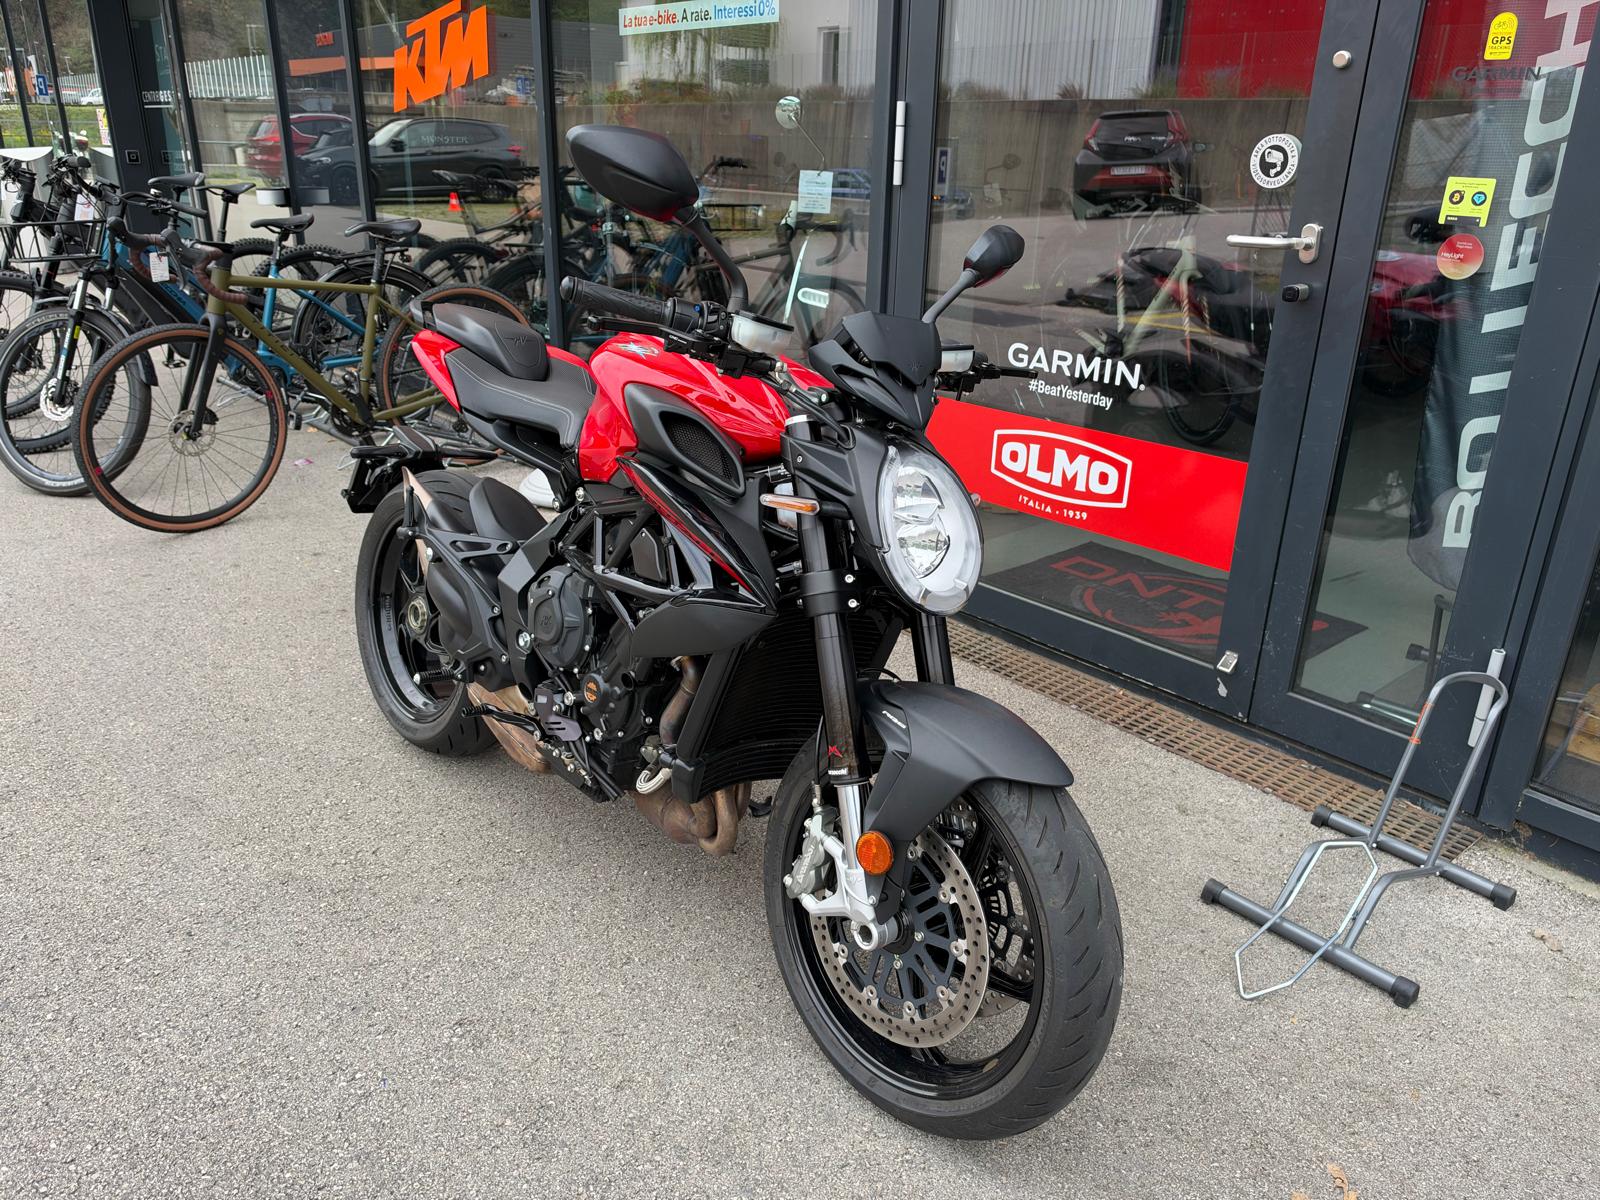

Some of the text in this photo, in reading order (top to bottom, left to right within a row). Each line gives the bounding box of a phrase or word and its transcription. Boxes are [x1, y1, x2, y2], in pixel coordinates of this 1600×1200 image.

[623, 0, 776, 28] La tua e-bike. A rate. Interessi 0%
[1491, 36, 1512, 45] GPS
[393, 0, 489, 113] KTM
[1451, 66, 1542, 81] GARMIN
[1254, 143, 1265, 159] AREA
[1251, 162, 1297, 186] VIDEOSORVEGLIANZA
[1028, 378, 1114, 411] #BeatYesterday
[1001, 441, 1119, 495] OLMO
[1018, 494, 1088, 520] ITALIA 1939
